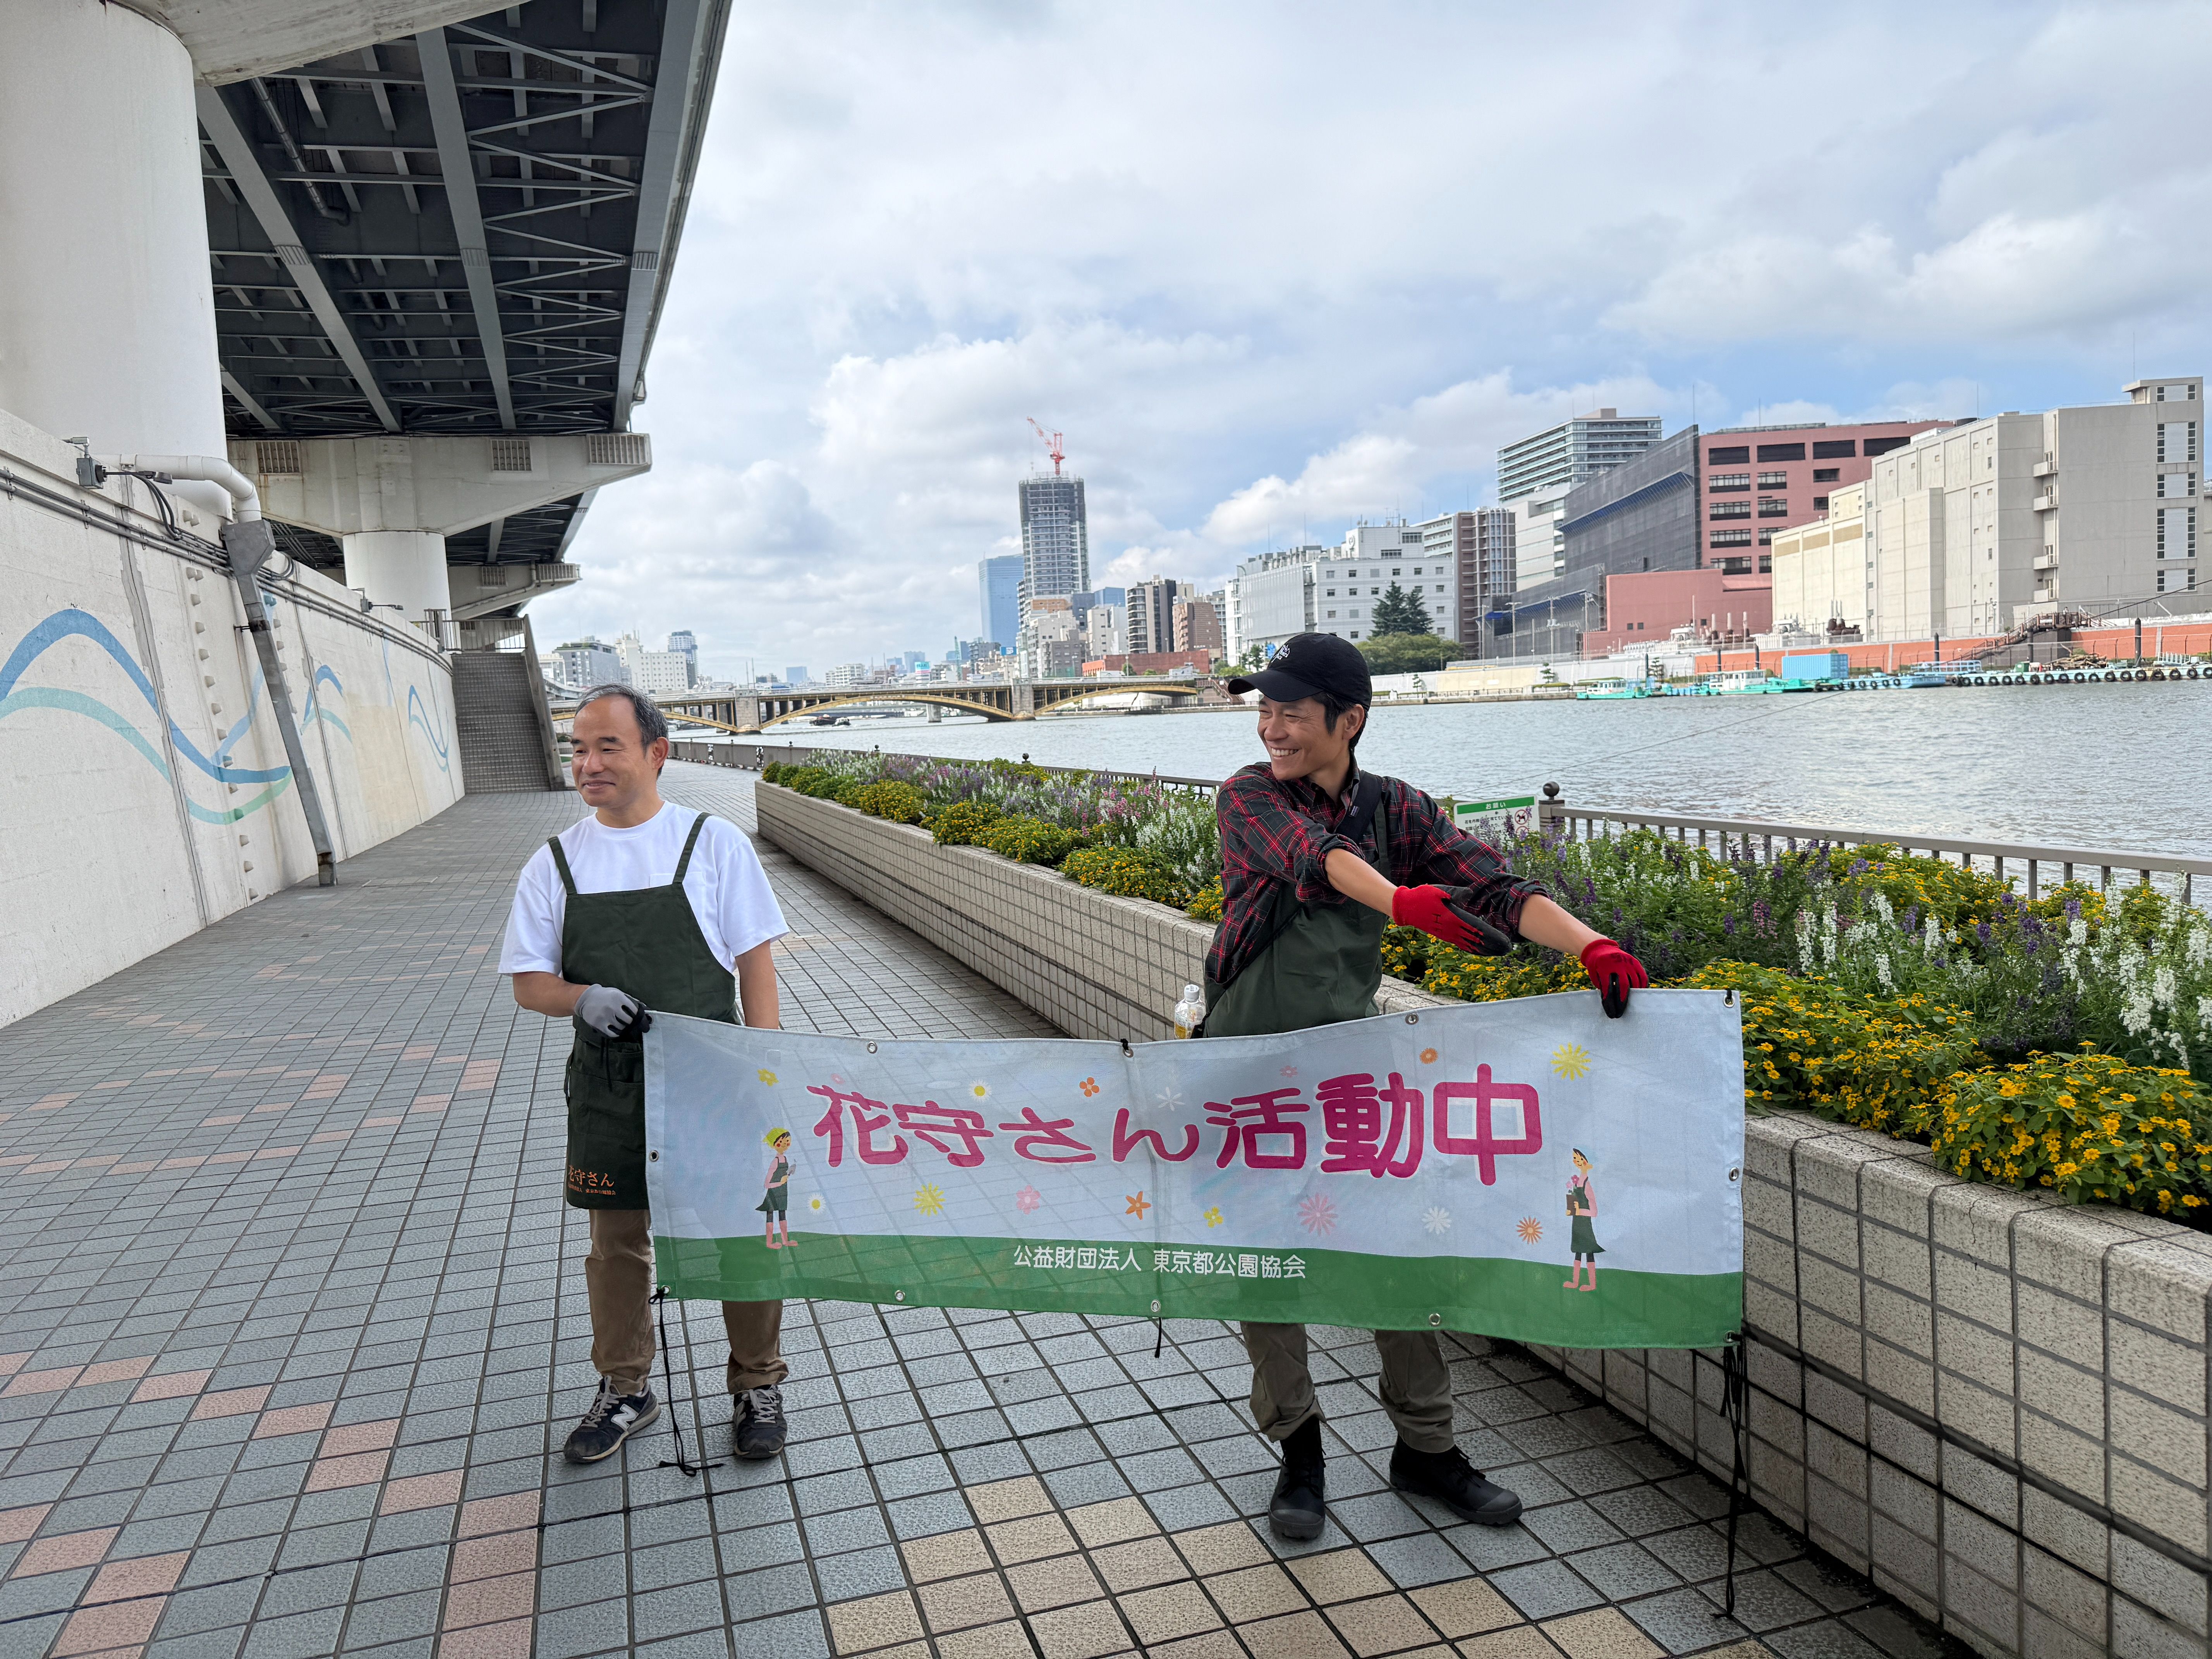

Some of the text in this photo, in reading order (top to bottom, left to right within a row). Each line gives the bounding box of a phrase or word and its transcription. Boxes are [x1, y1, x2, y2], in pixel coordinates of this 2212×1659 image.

[806, 1063, 1542, 1186] 花守さん活動中
[1013, 1245, 1306, 1279] 公益財団法人 東京都公園協会
